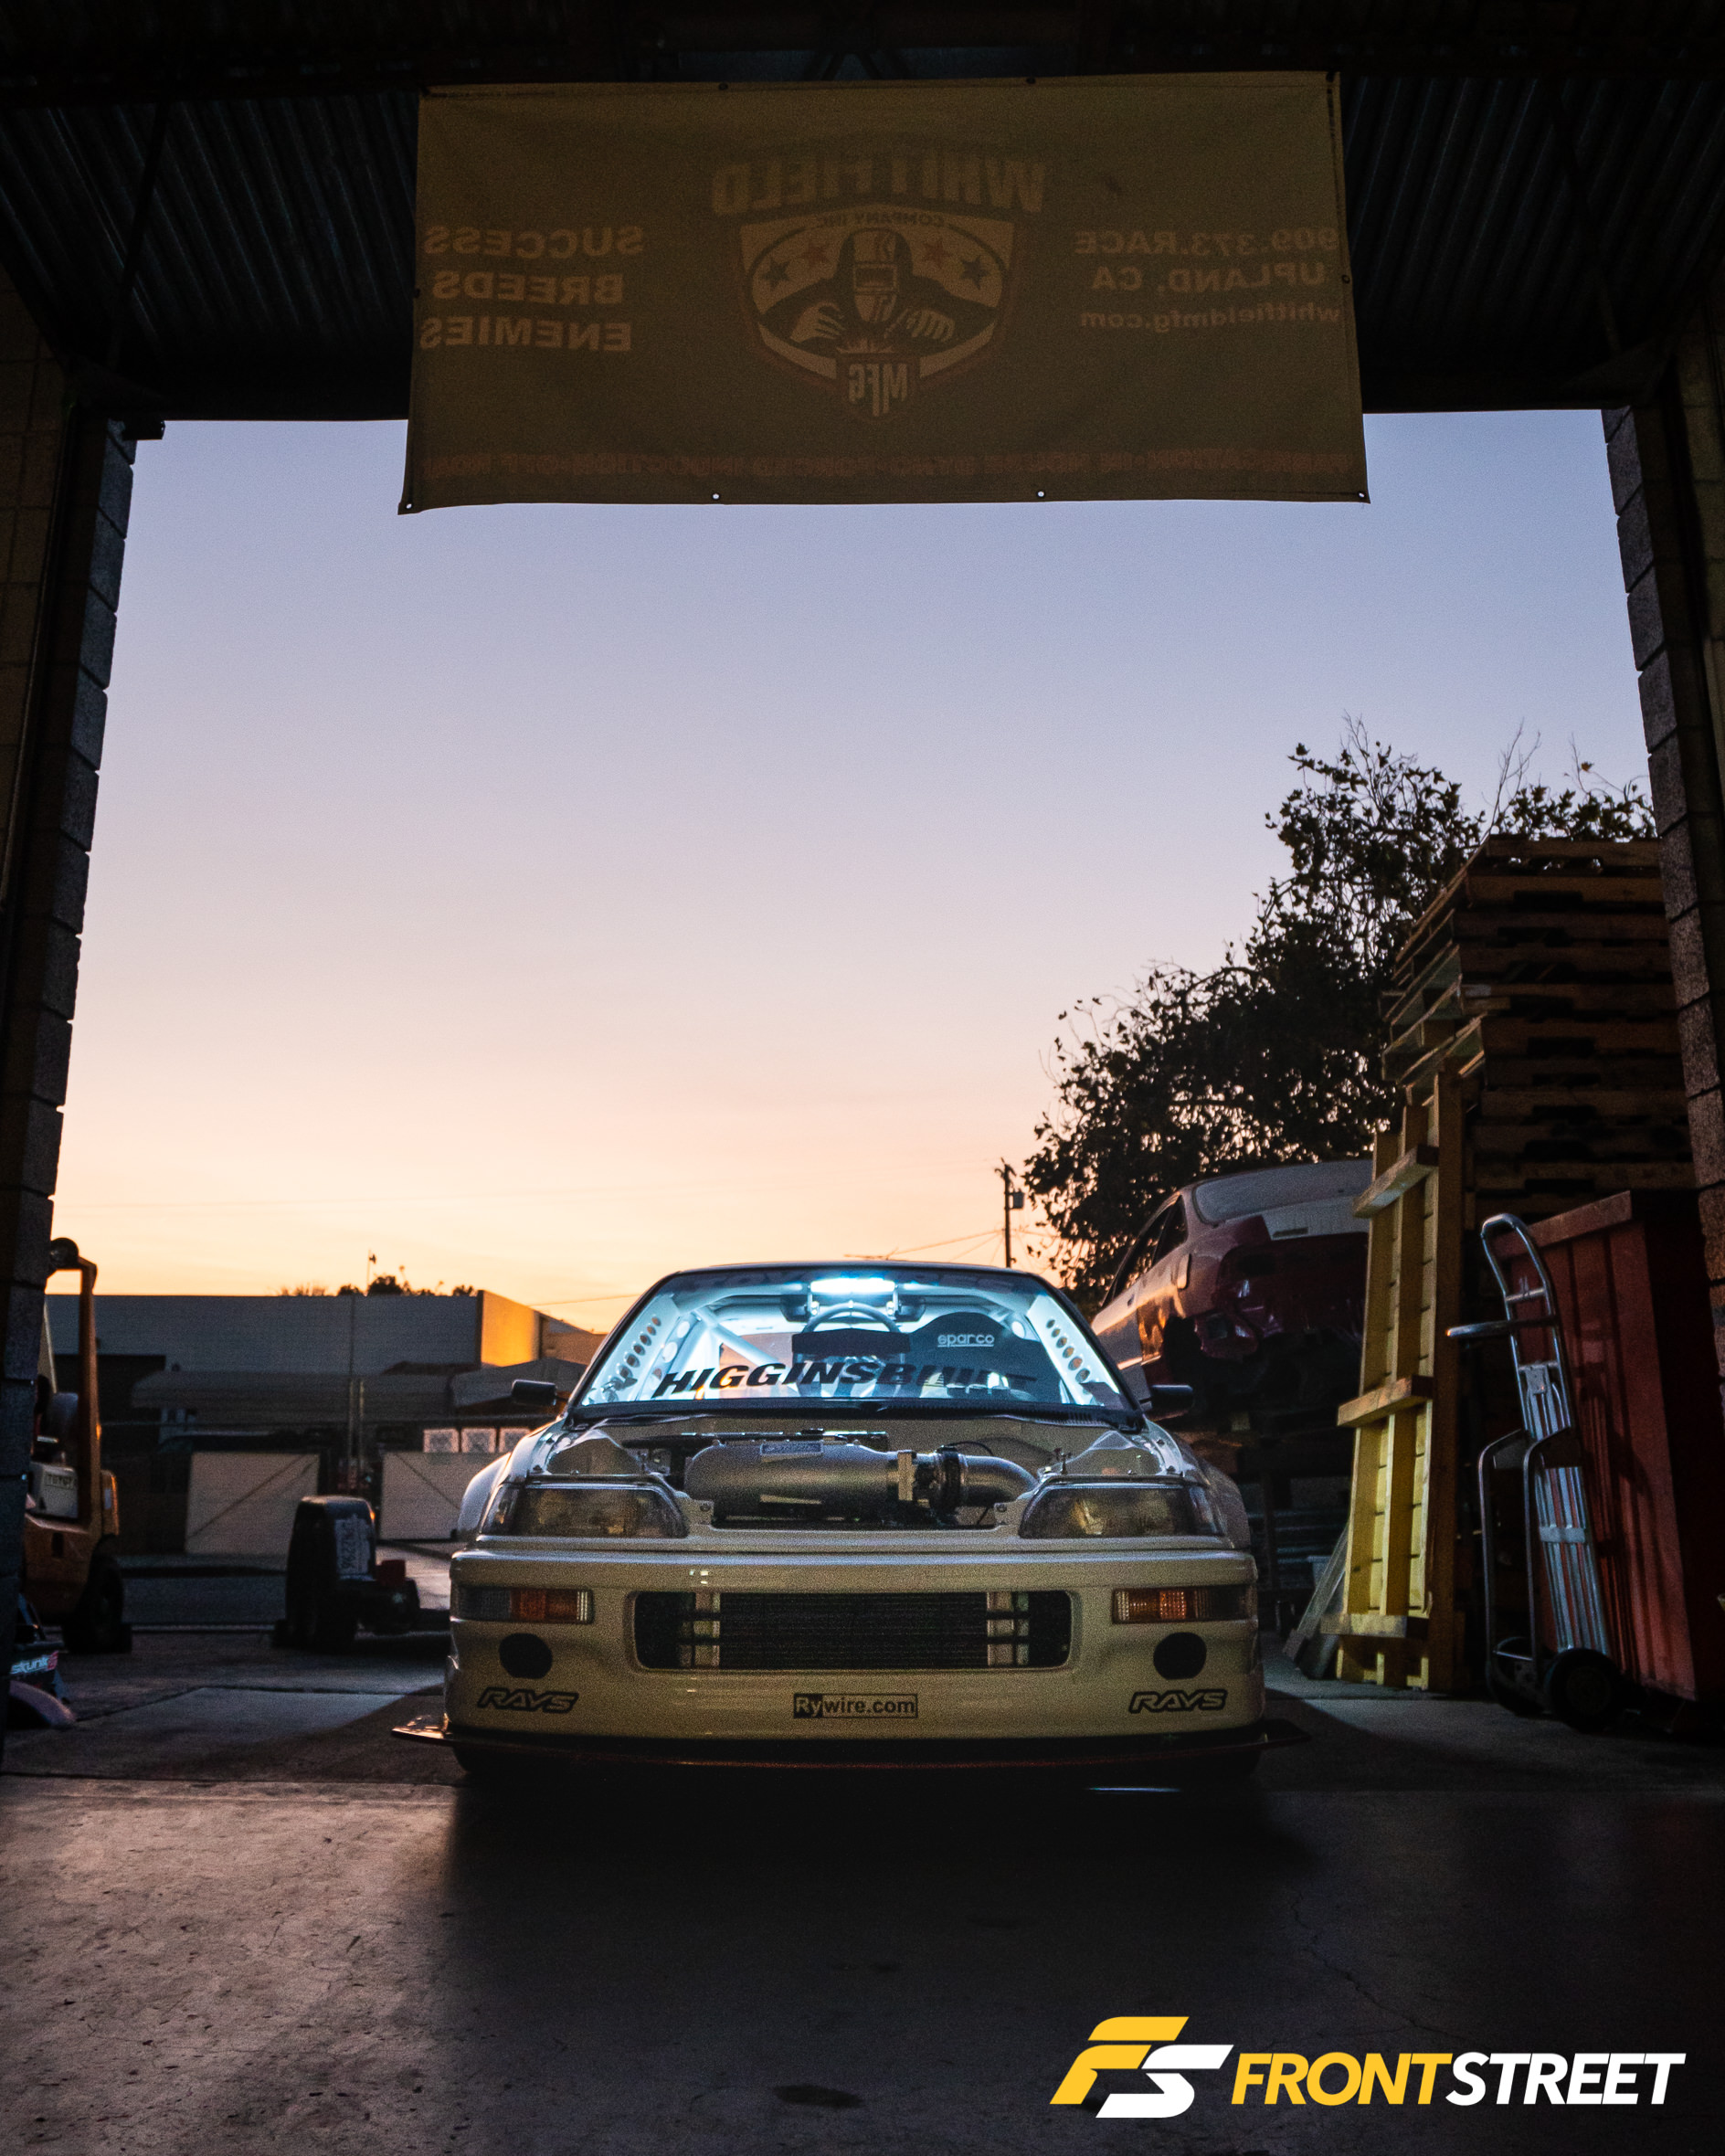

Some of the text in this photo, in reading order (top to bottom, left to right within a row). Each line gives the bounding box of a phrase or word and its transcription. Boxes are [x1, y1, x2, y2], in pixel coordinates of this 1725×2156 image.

[937, 1334, 995, 1348] sparco
[478, 1687, 577, 1713] RAYS
[794, 1694, 915, 1717] Rywire.com
[1129, 1688, 1227, 1713] RAYS
